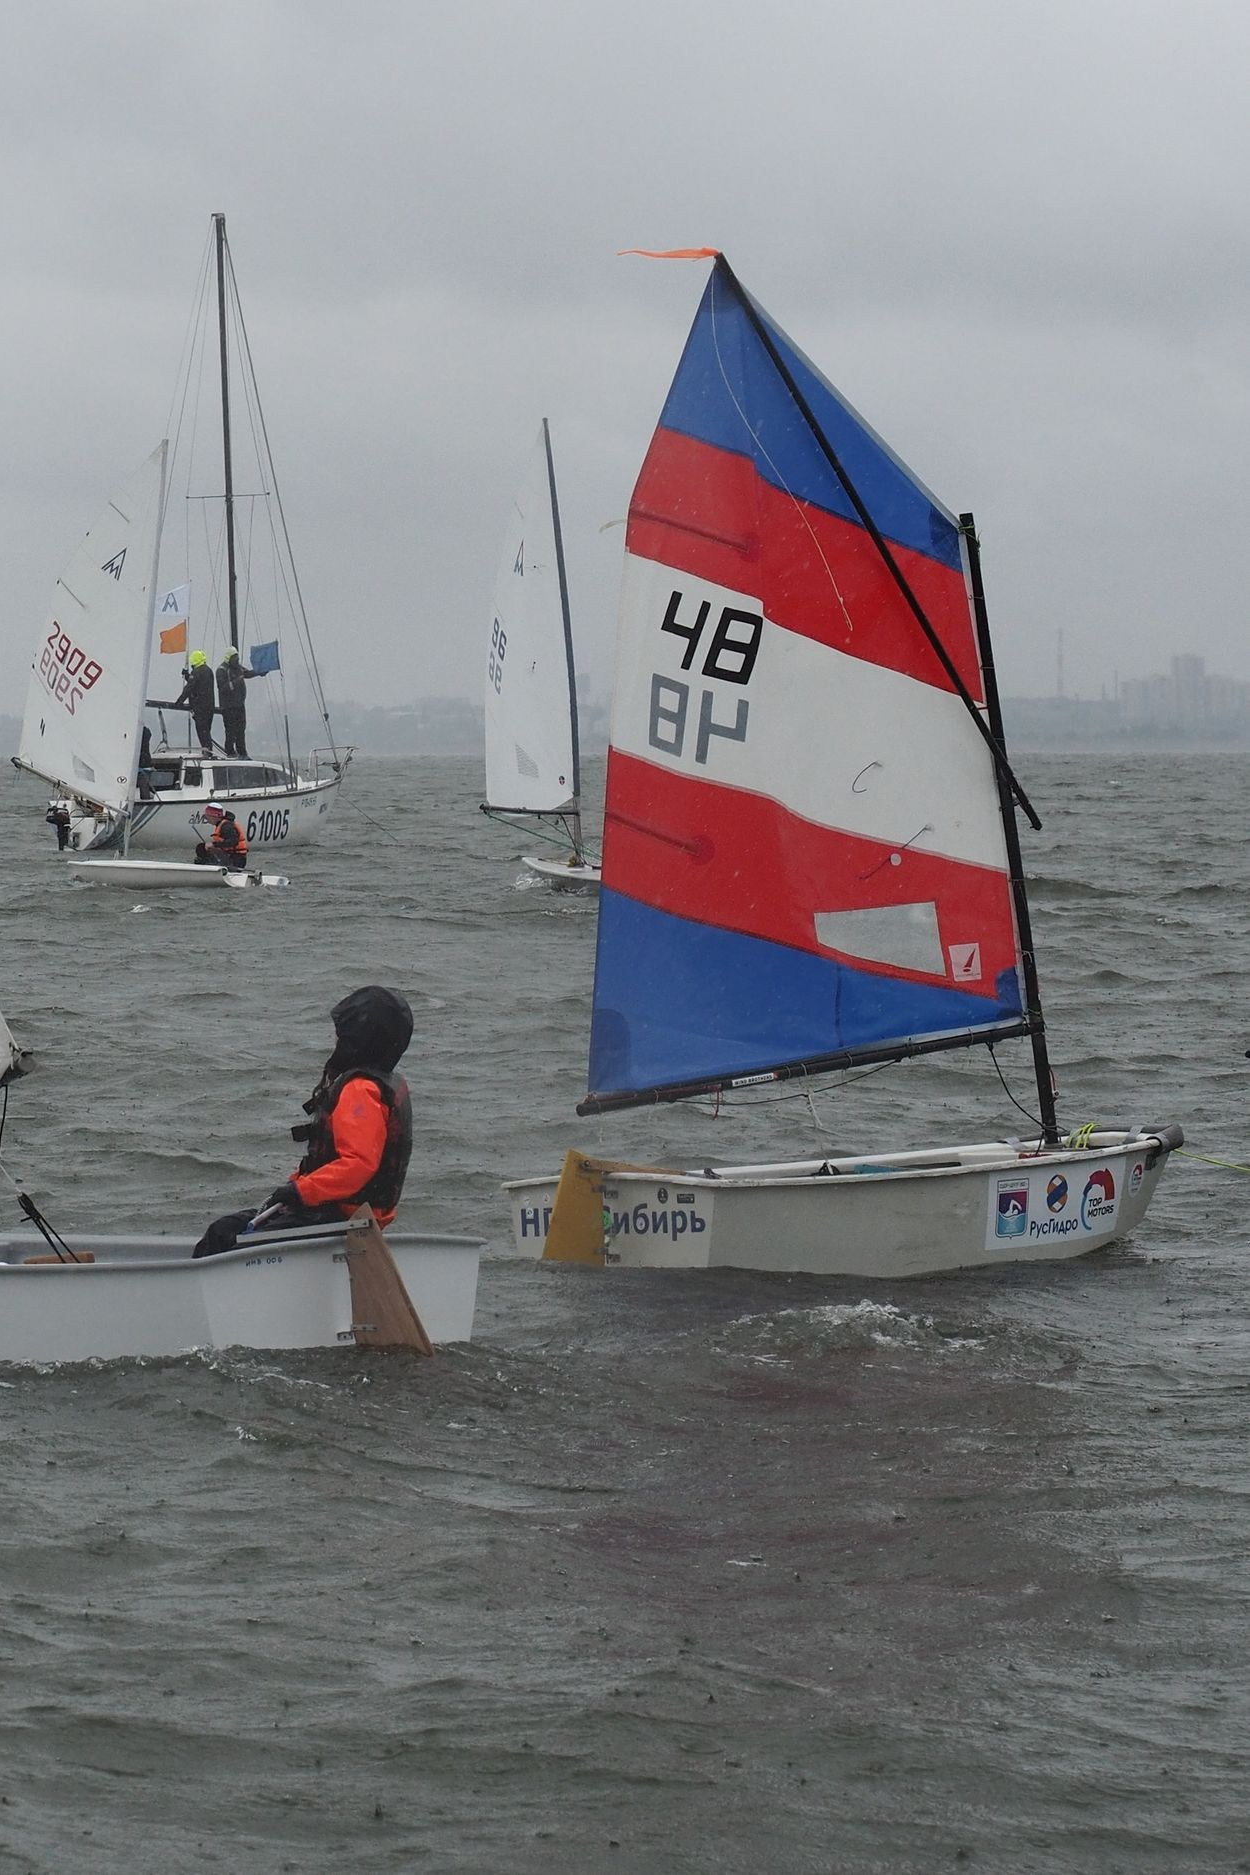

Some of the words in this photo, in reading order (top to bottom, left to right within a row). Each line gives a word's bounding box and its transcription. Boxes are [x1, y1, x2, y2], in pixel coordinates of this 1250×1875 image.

[661, 590, 764, 685] 48
[47, 620, 103, 690] 2909
[246, 808, 291, 842] 61005
[1087, 1204, 1115, 1218] MOTORS
[1088, 1197, 1103, 1208] TOP
[1029, 1218, 1079, 1239] РусГидро
